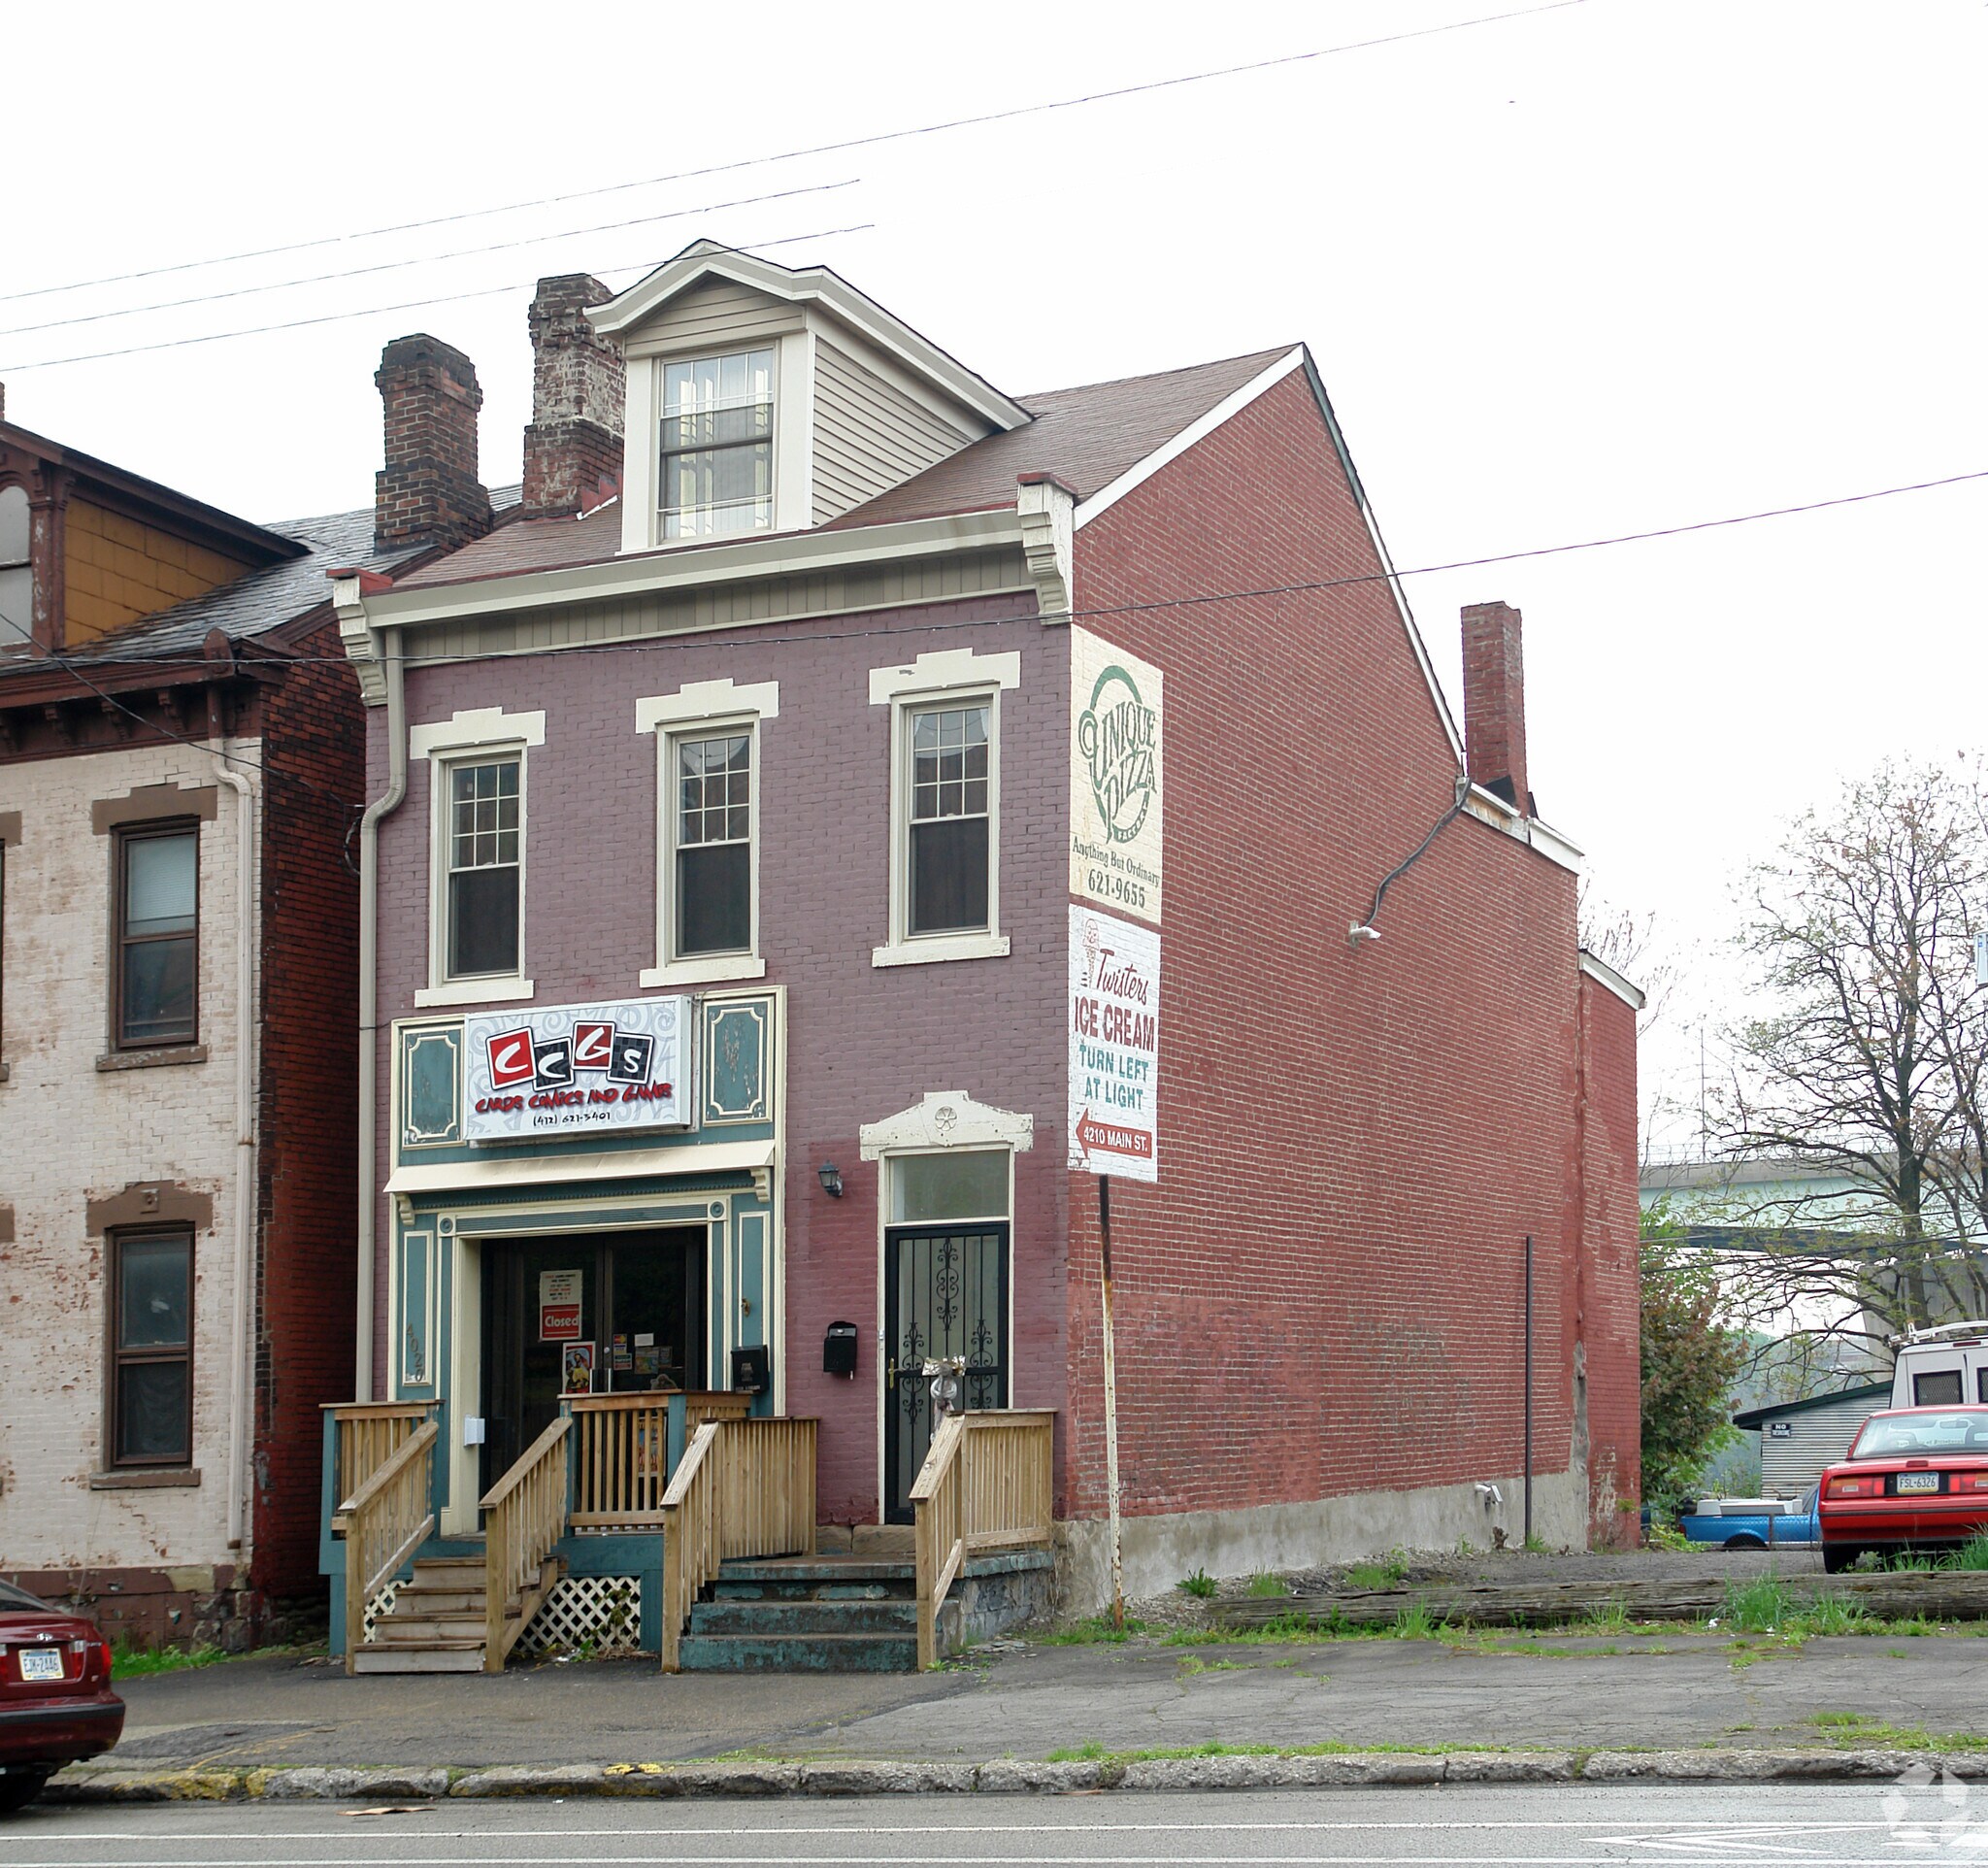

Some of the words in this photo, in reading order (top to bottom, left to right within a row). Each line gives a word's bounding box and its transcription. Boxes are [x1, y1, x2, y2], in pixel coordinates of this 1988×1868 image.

[1078, 701, 1156, 790] UNIQUE
[1104, 750, 1157, 844] PIZZA
[1073, 836, 1109, 868] Anything
[1110, 851, 1125, 871] But
[1127, 858, 1160, 888] Ordinary
[1096, 948, 1149, 1006] Twisters
[1074, 995, 1098, 1038] ICE
[1103, 1003, 1155, 1052] CREAM
[1079, 1044, 1114, 1075] TURN
[1118, 1054, 1149, 1084] LEFT
[475, 1095, 524, 1114] CARDS
[587, 1088, 618, 1105] AND
[622, 1080, 673, 1103] GAMES
[1084, 1077, 1101, 1101] AT
[1106, 1082, 1143, 1111] LIGHT
[533, 1114, 558, 1126] (412)
[1082, 1125, 1105, 1145] 4210
[1107, 1129, 1132, 1151] MAIN
[1134, 1136, 1148, 1152] ST.
[545, 1315, 580, 1327] Closed
[407, 1323, 424, 1383] 4020
